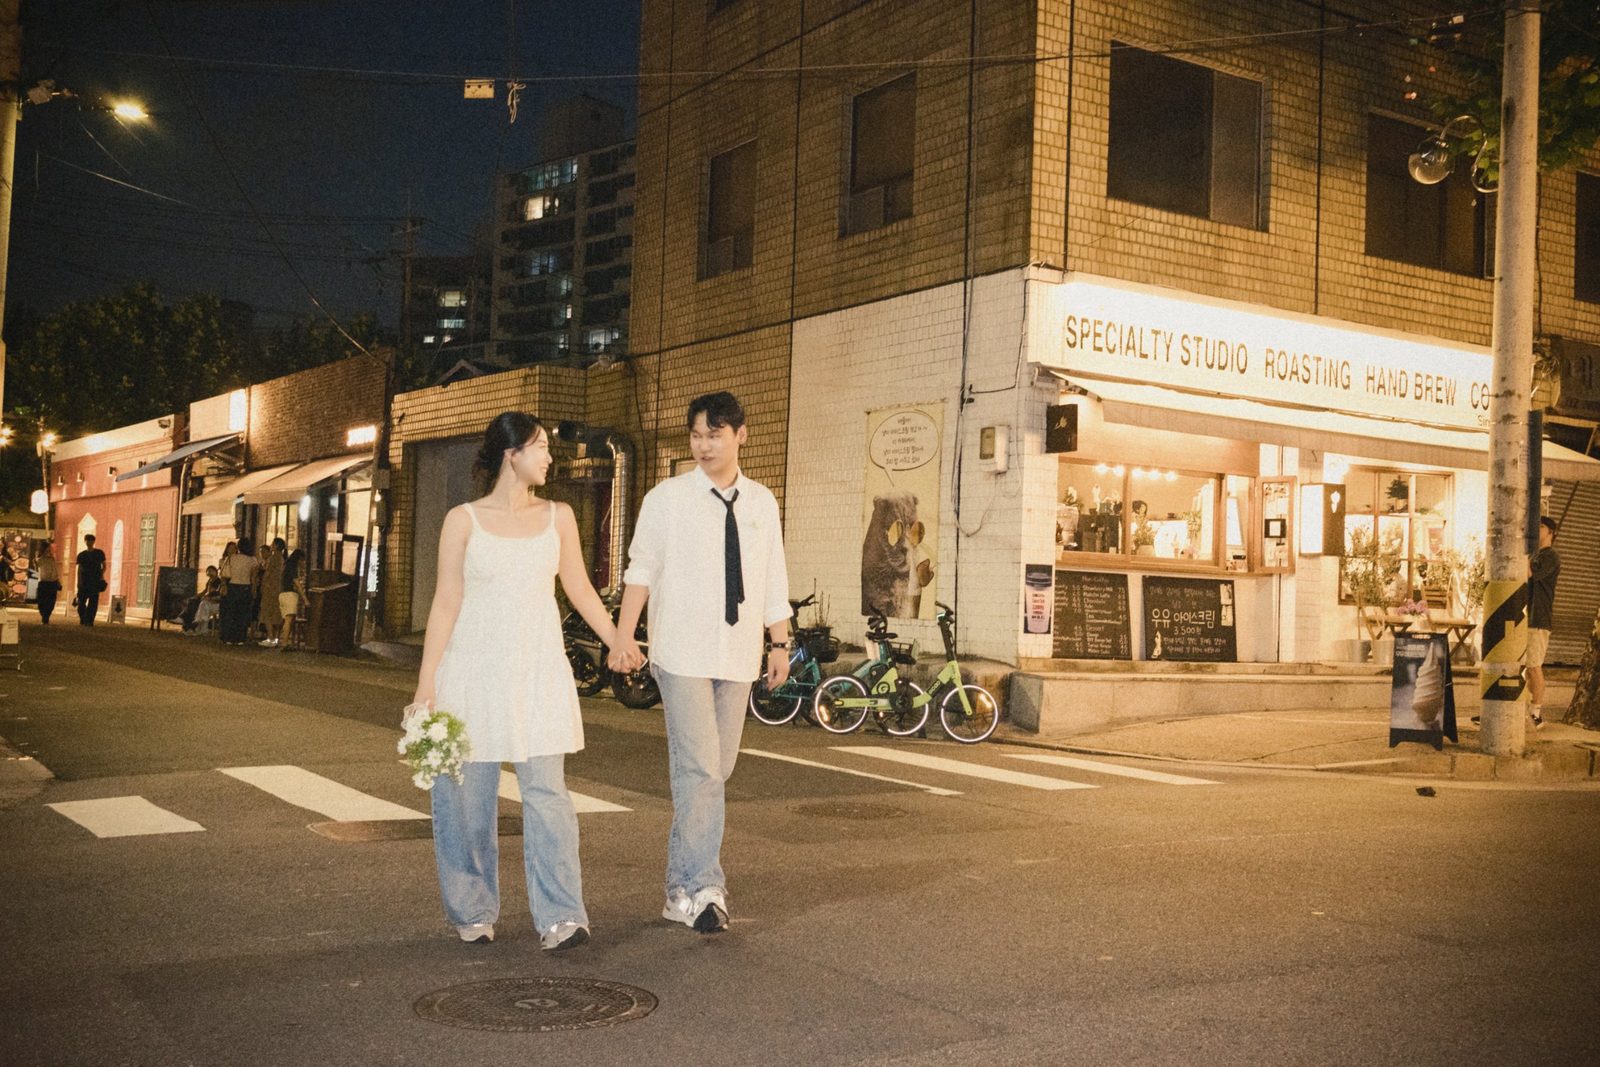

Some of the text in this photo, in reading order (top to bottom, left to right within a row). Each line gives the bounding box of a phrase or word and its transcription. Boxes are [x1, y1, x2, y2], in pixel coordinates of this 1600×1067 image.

[1065, 315, 1490, 411] SPECIALTY STUDIO ROASTING HAND BREW CO
[1152, 608, 1216, 629] 우유 아이스크림
